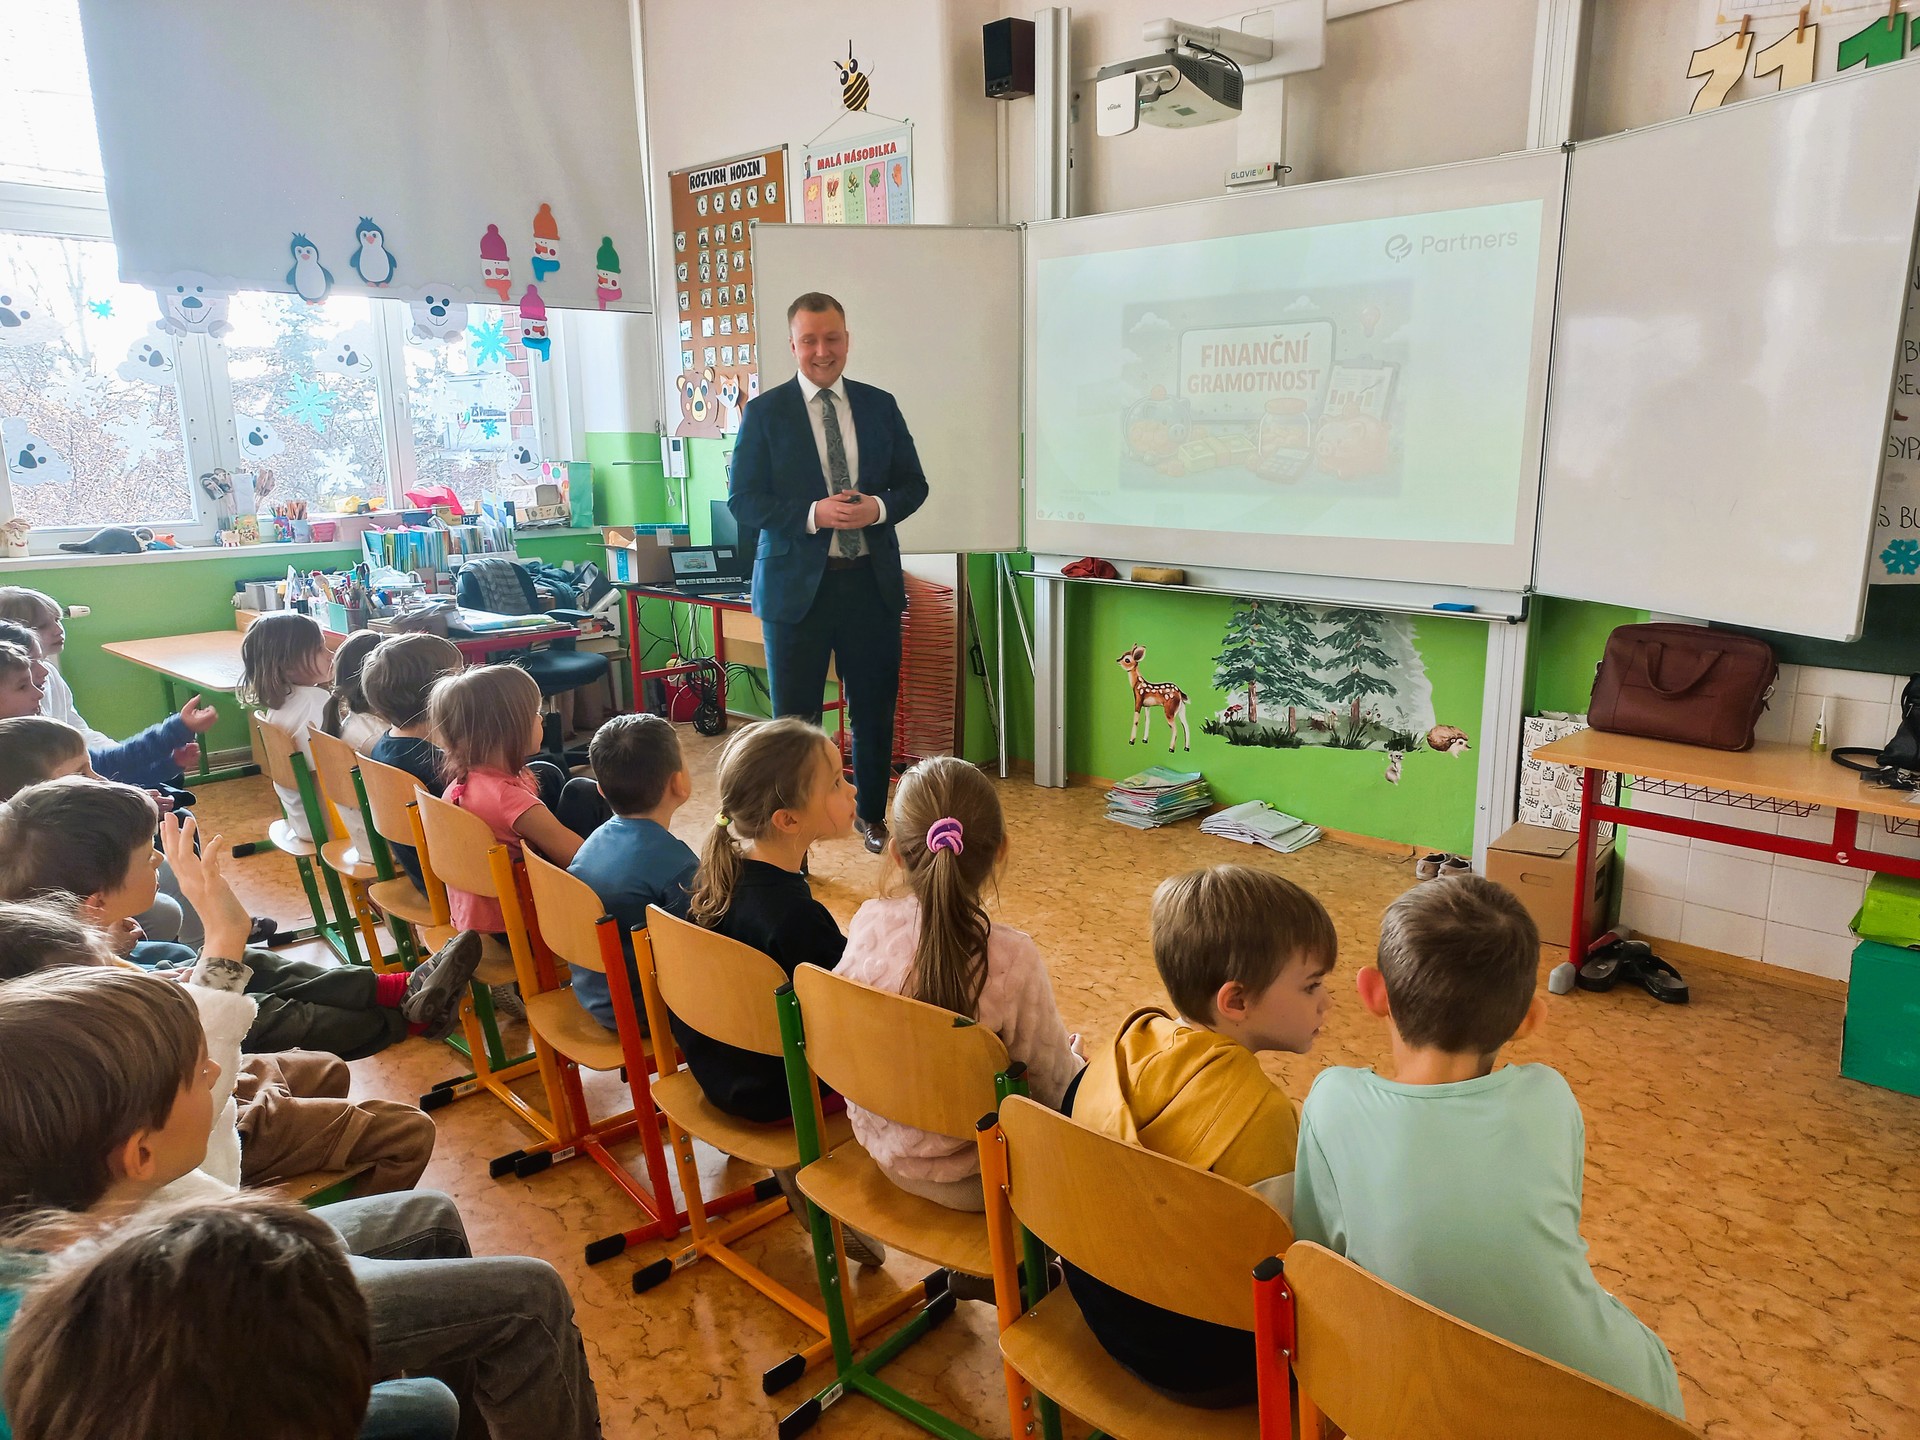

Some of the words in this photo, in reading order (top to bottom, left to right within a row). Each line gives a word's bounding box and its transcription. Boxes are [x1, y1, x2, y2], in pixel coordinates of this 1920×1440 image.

[817, 153, 841, 171] MALÁ
[843, 142, 897, 165] NÁSOBILKA
[689, 168, 727, 191] ROZVRH
[730, 159, 761, 182] HODIN
[1230, 167, 1265, 180] GLOVIEW
[716, 198, 723, 207] 2.
[733, 195, 740, 204] 3.
[750, 192, 756, 201] 4.
[768, 188, 775, 198] 5.
[1421, 231, 1519, 255] Partners
[681, 297, 688, 306] ST
[1200, 331, 1312, 368] FINANČNÍ
[1187, 369, 1321, 395] GRAMOTNOST
